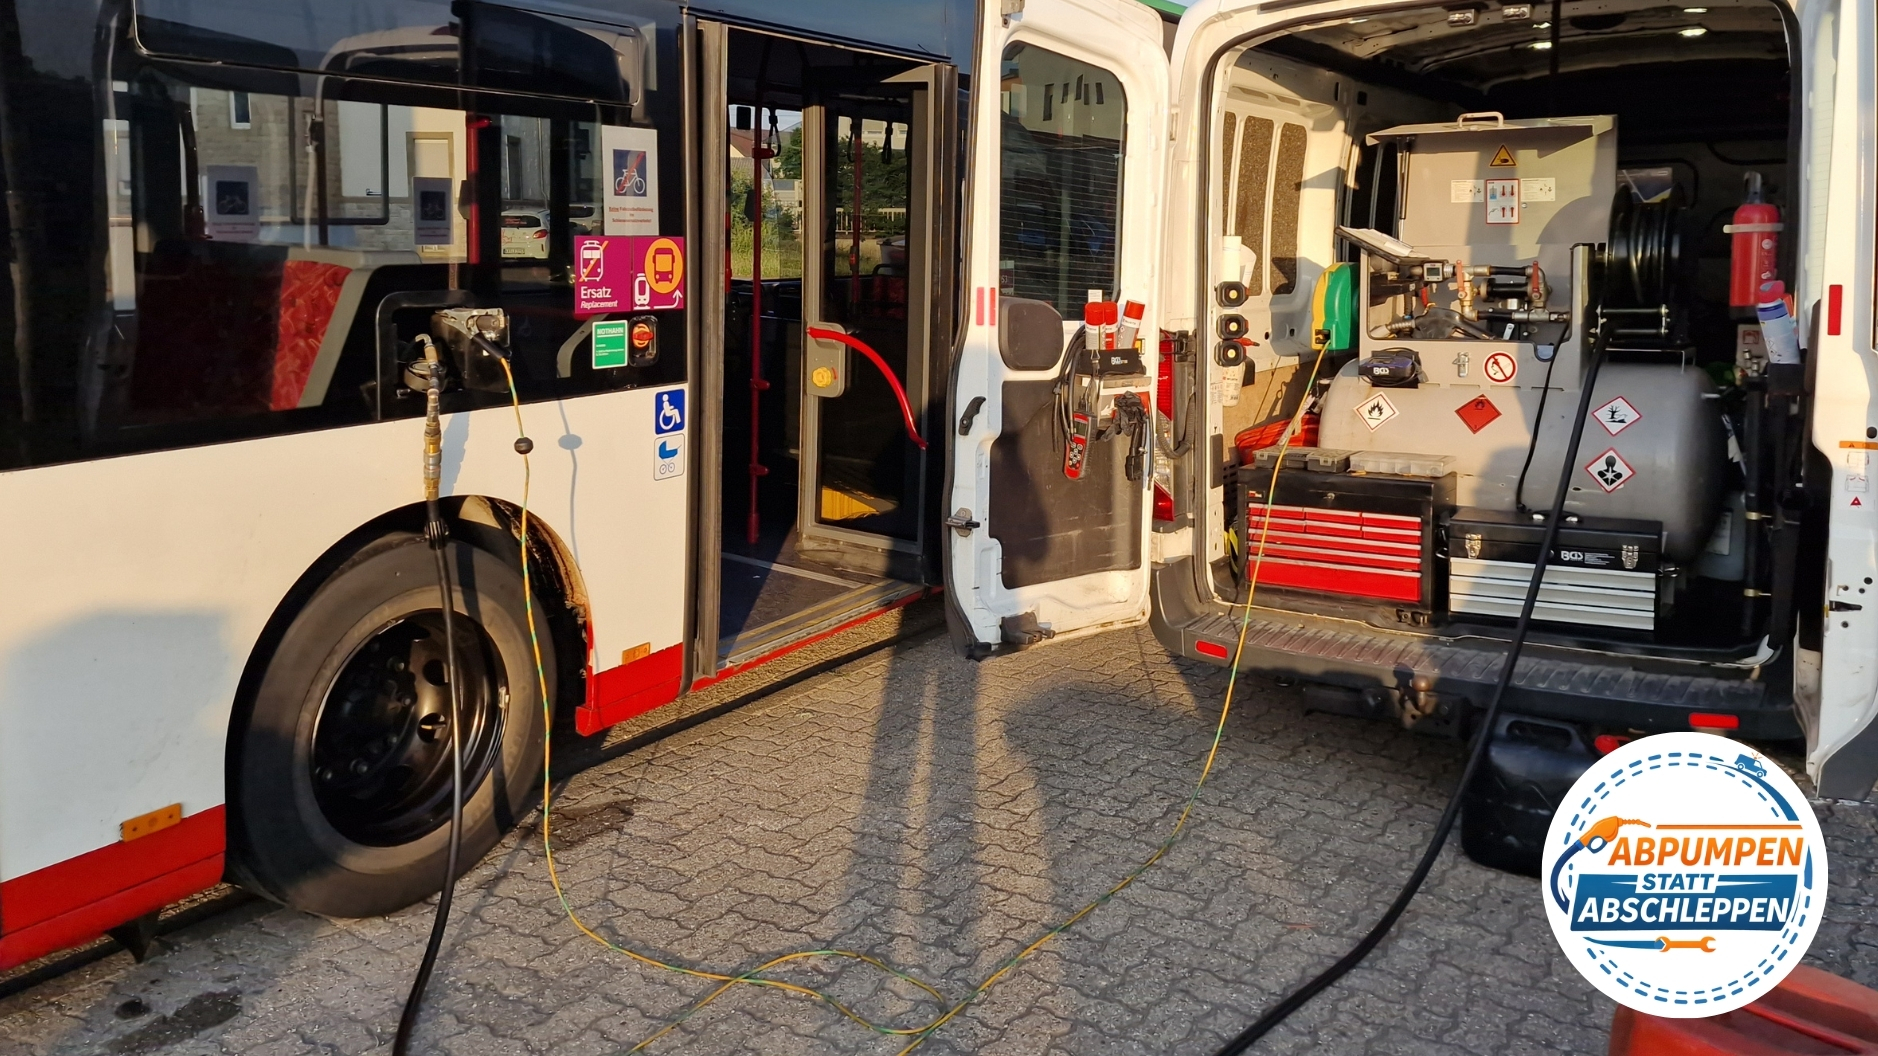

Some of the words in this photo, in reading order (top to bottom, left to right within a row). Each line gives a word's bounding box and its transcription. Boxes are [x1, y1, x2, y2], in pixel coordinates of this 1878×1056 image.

[580, 286, 612, 299] Ersatz
[580, 300, 618, 310] Replacement
[597, 327, 624, 335] NOTHAHN
